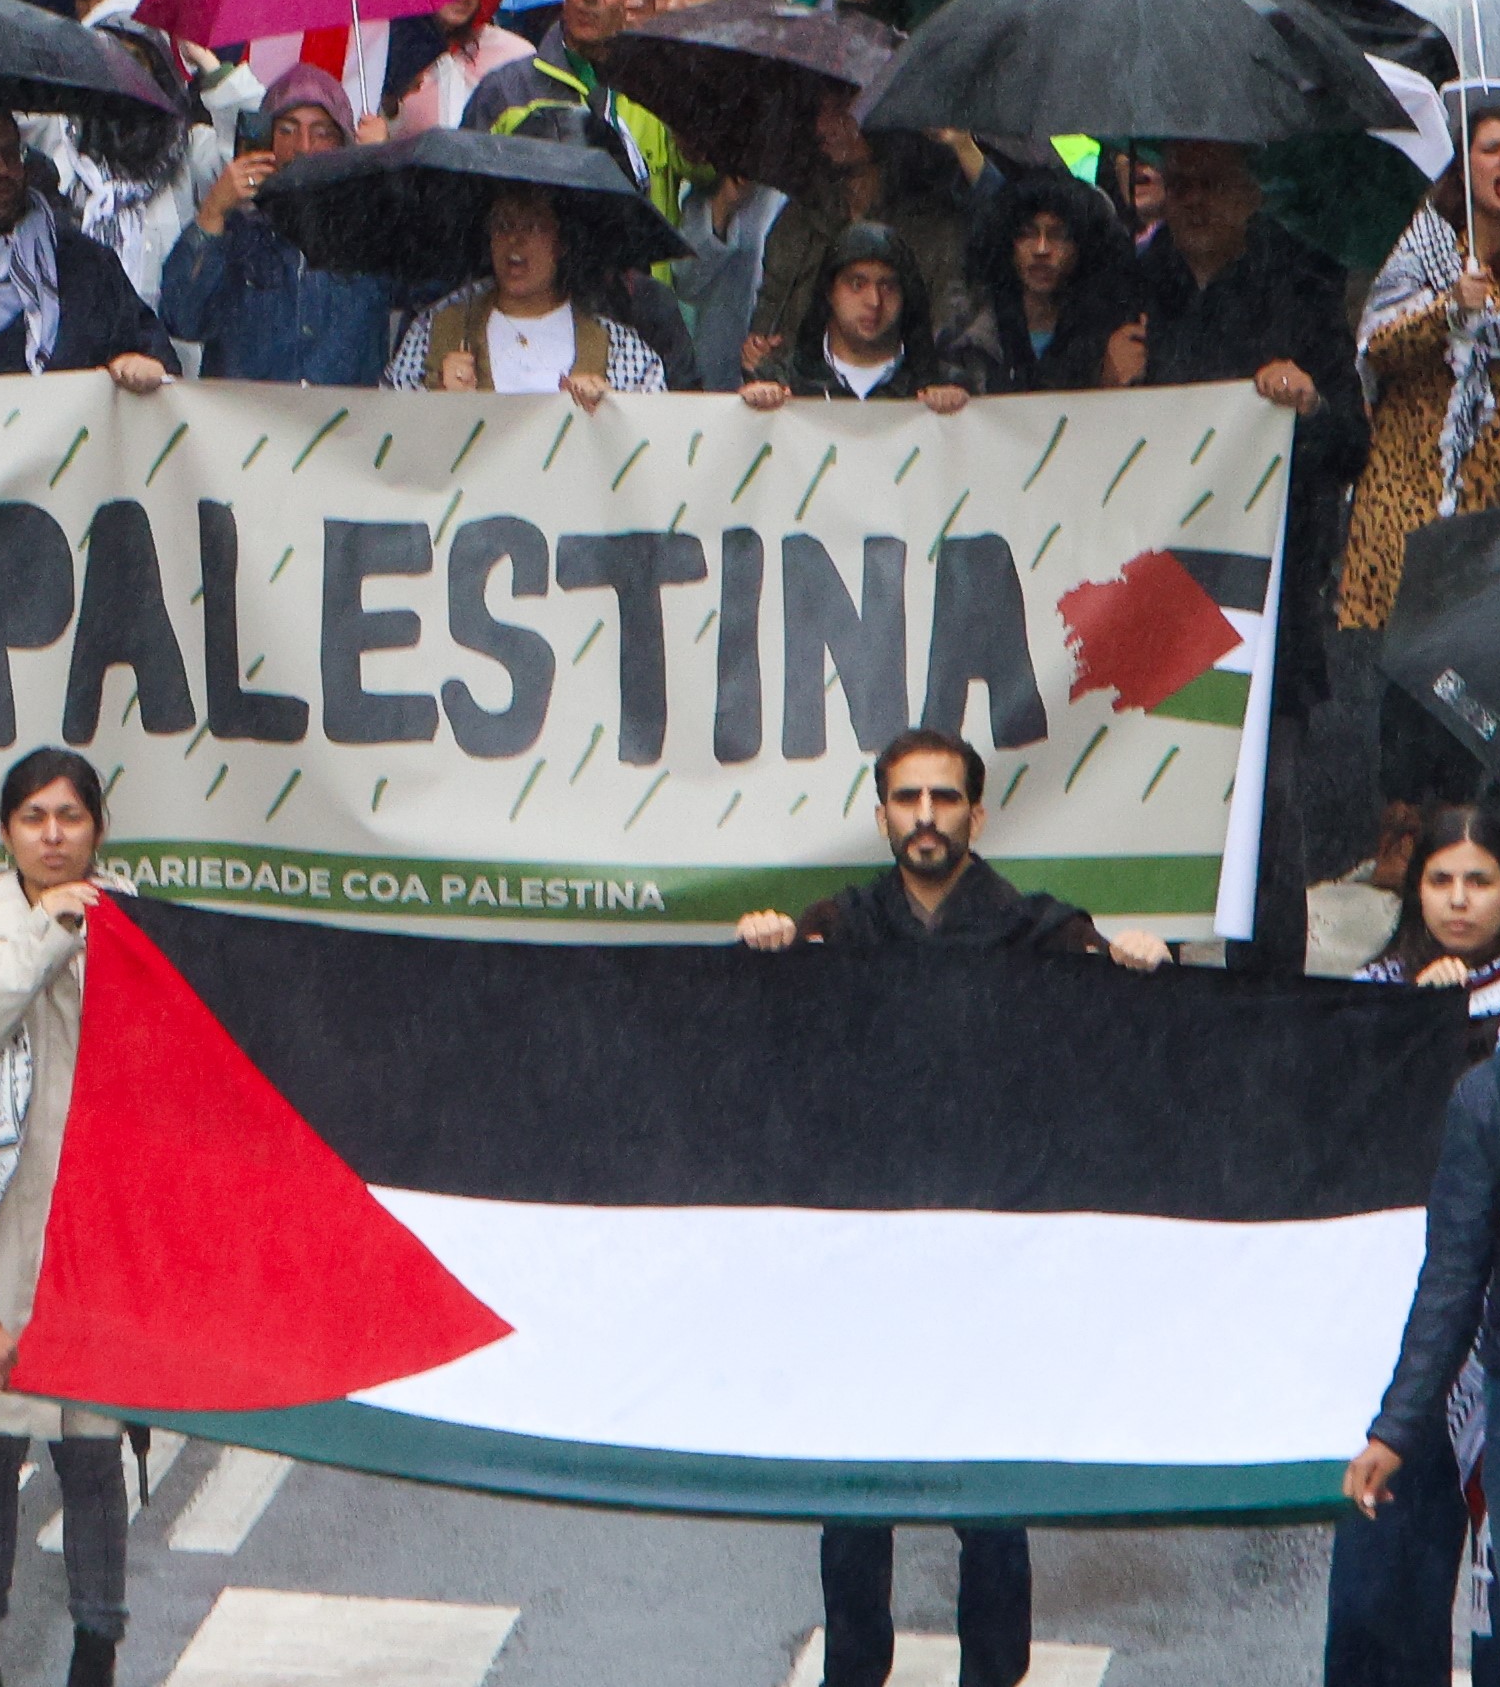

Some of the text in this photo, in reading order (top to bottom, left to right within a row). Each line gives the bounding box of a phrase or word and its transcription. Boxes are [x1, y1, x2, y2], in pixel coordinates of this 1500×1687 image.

[100, 855, 332, 899] DARIEDADE
[342, 869, 431, 905] COA
[441, 873, 665, 912] PALESTINA
